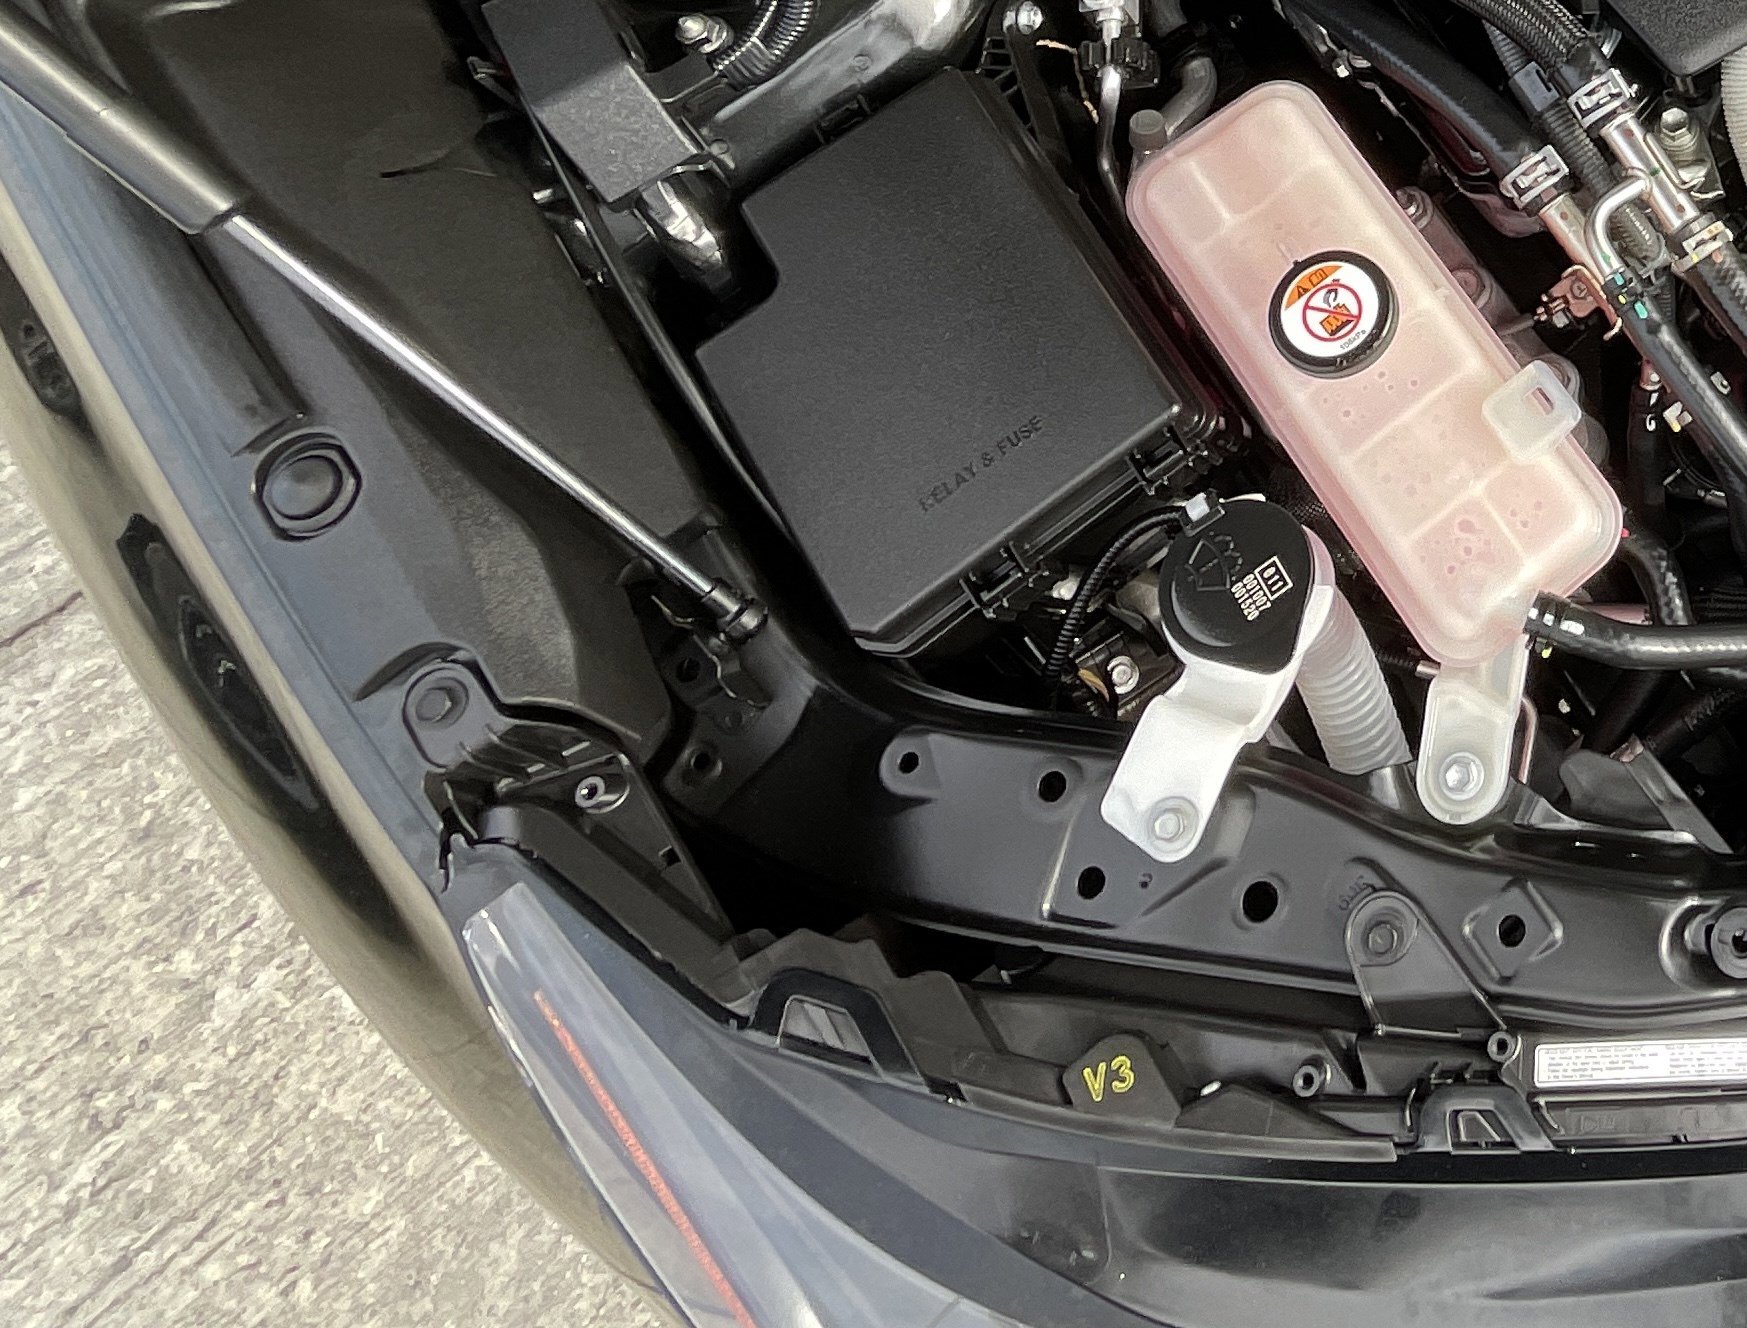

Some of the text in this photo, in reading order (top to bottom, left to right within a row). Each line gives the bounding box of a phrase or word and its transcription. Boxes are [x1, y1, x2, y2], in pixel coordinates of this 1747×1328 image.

[981, 452, 995, 467] &
[997, 415, 1042, 456] FUSE
[1243, 573, 1272, 611] 001007
[1262, 566, 1283, 592] 011
[1230, 582, 1260, 621] 001520
[1082, 1055, 1135, 1102] V3
